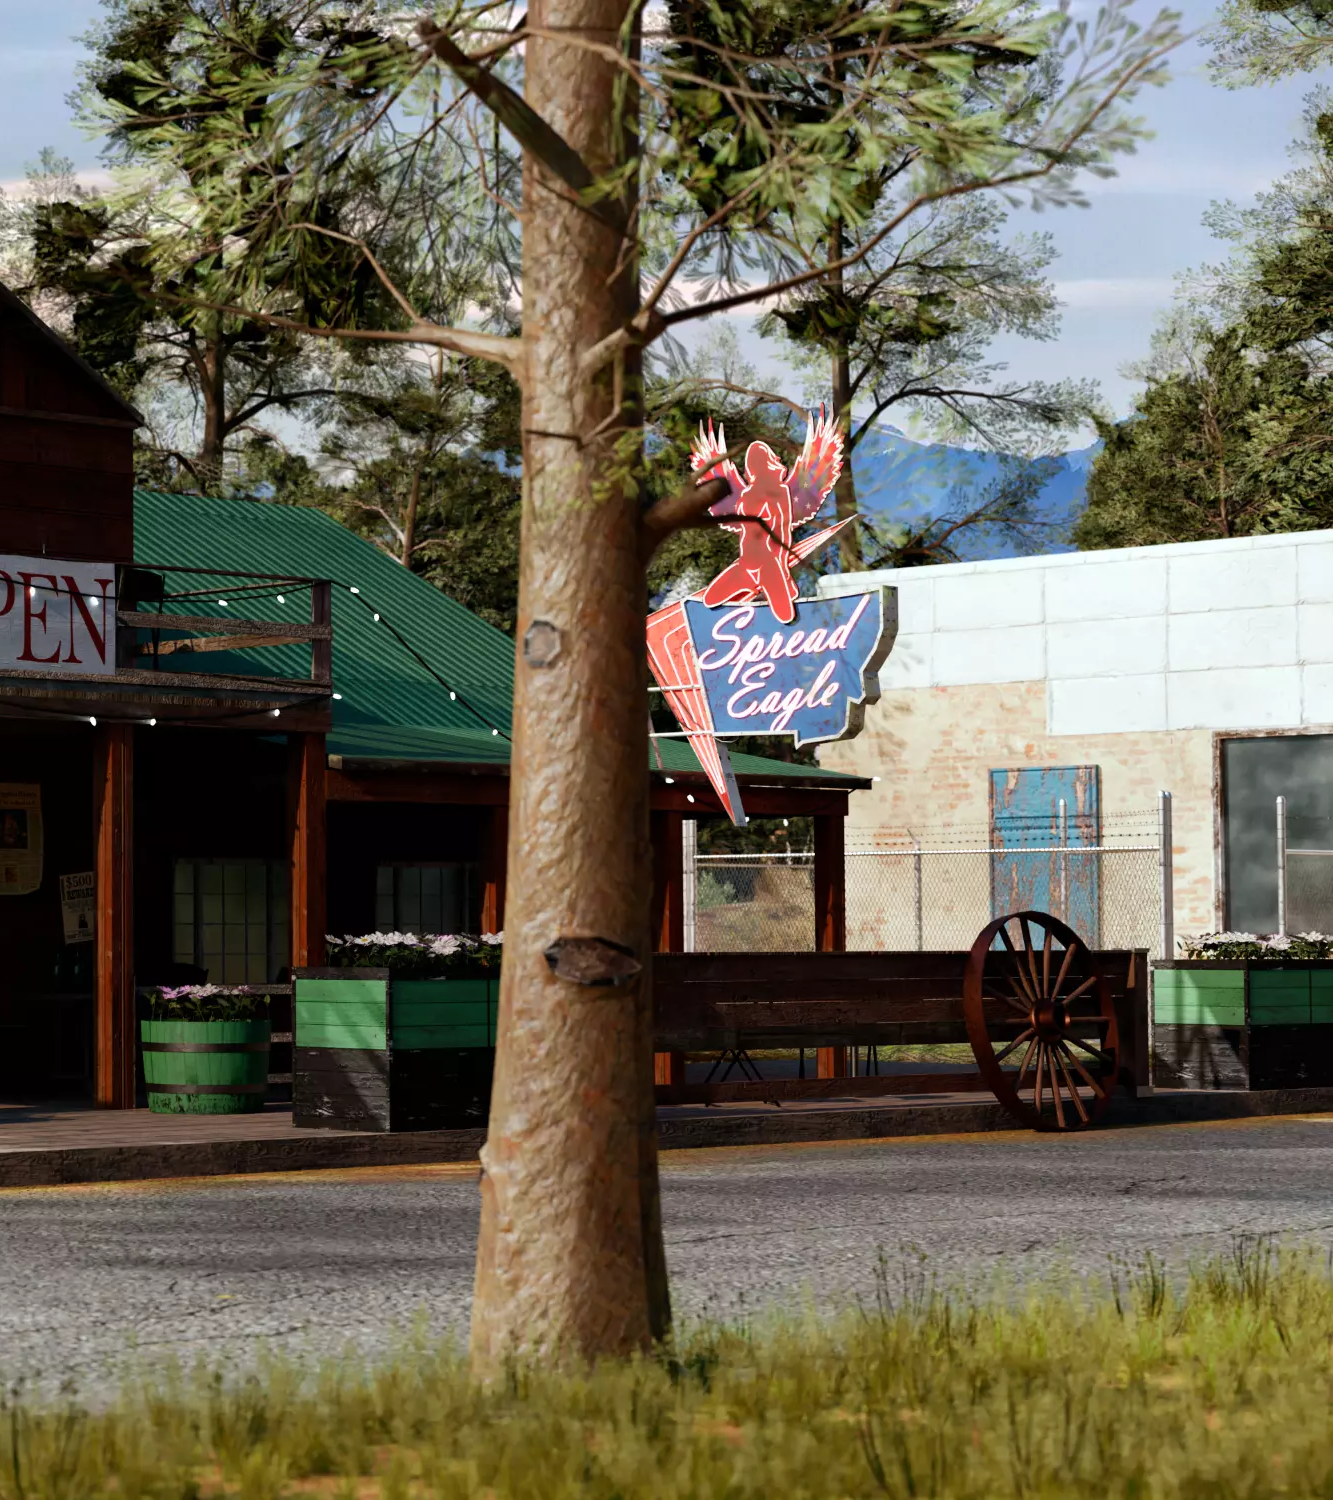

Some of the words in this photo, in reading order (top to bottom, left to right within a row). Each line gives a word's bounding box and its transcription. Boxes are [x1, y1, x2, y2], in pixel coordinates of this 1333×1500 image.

[698, 593, 870, 684] Spread
[726, 660, 840, 731] Eagle
[66, 874, 92, 889] $500
